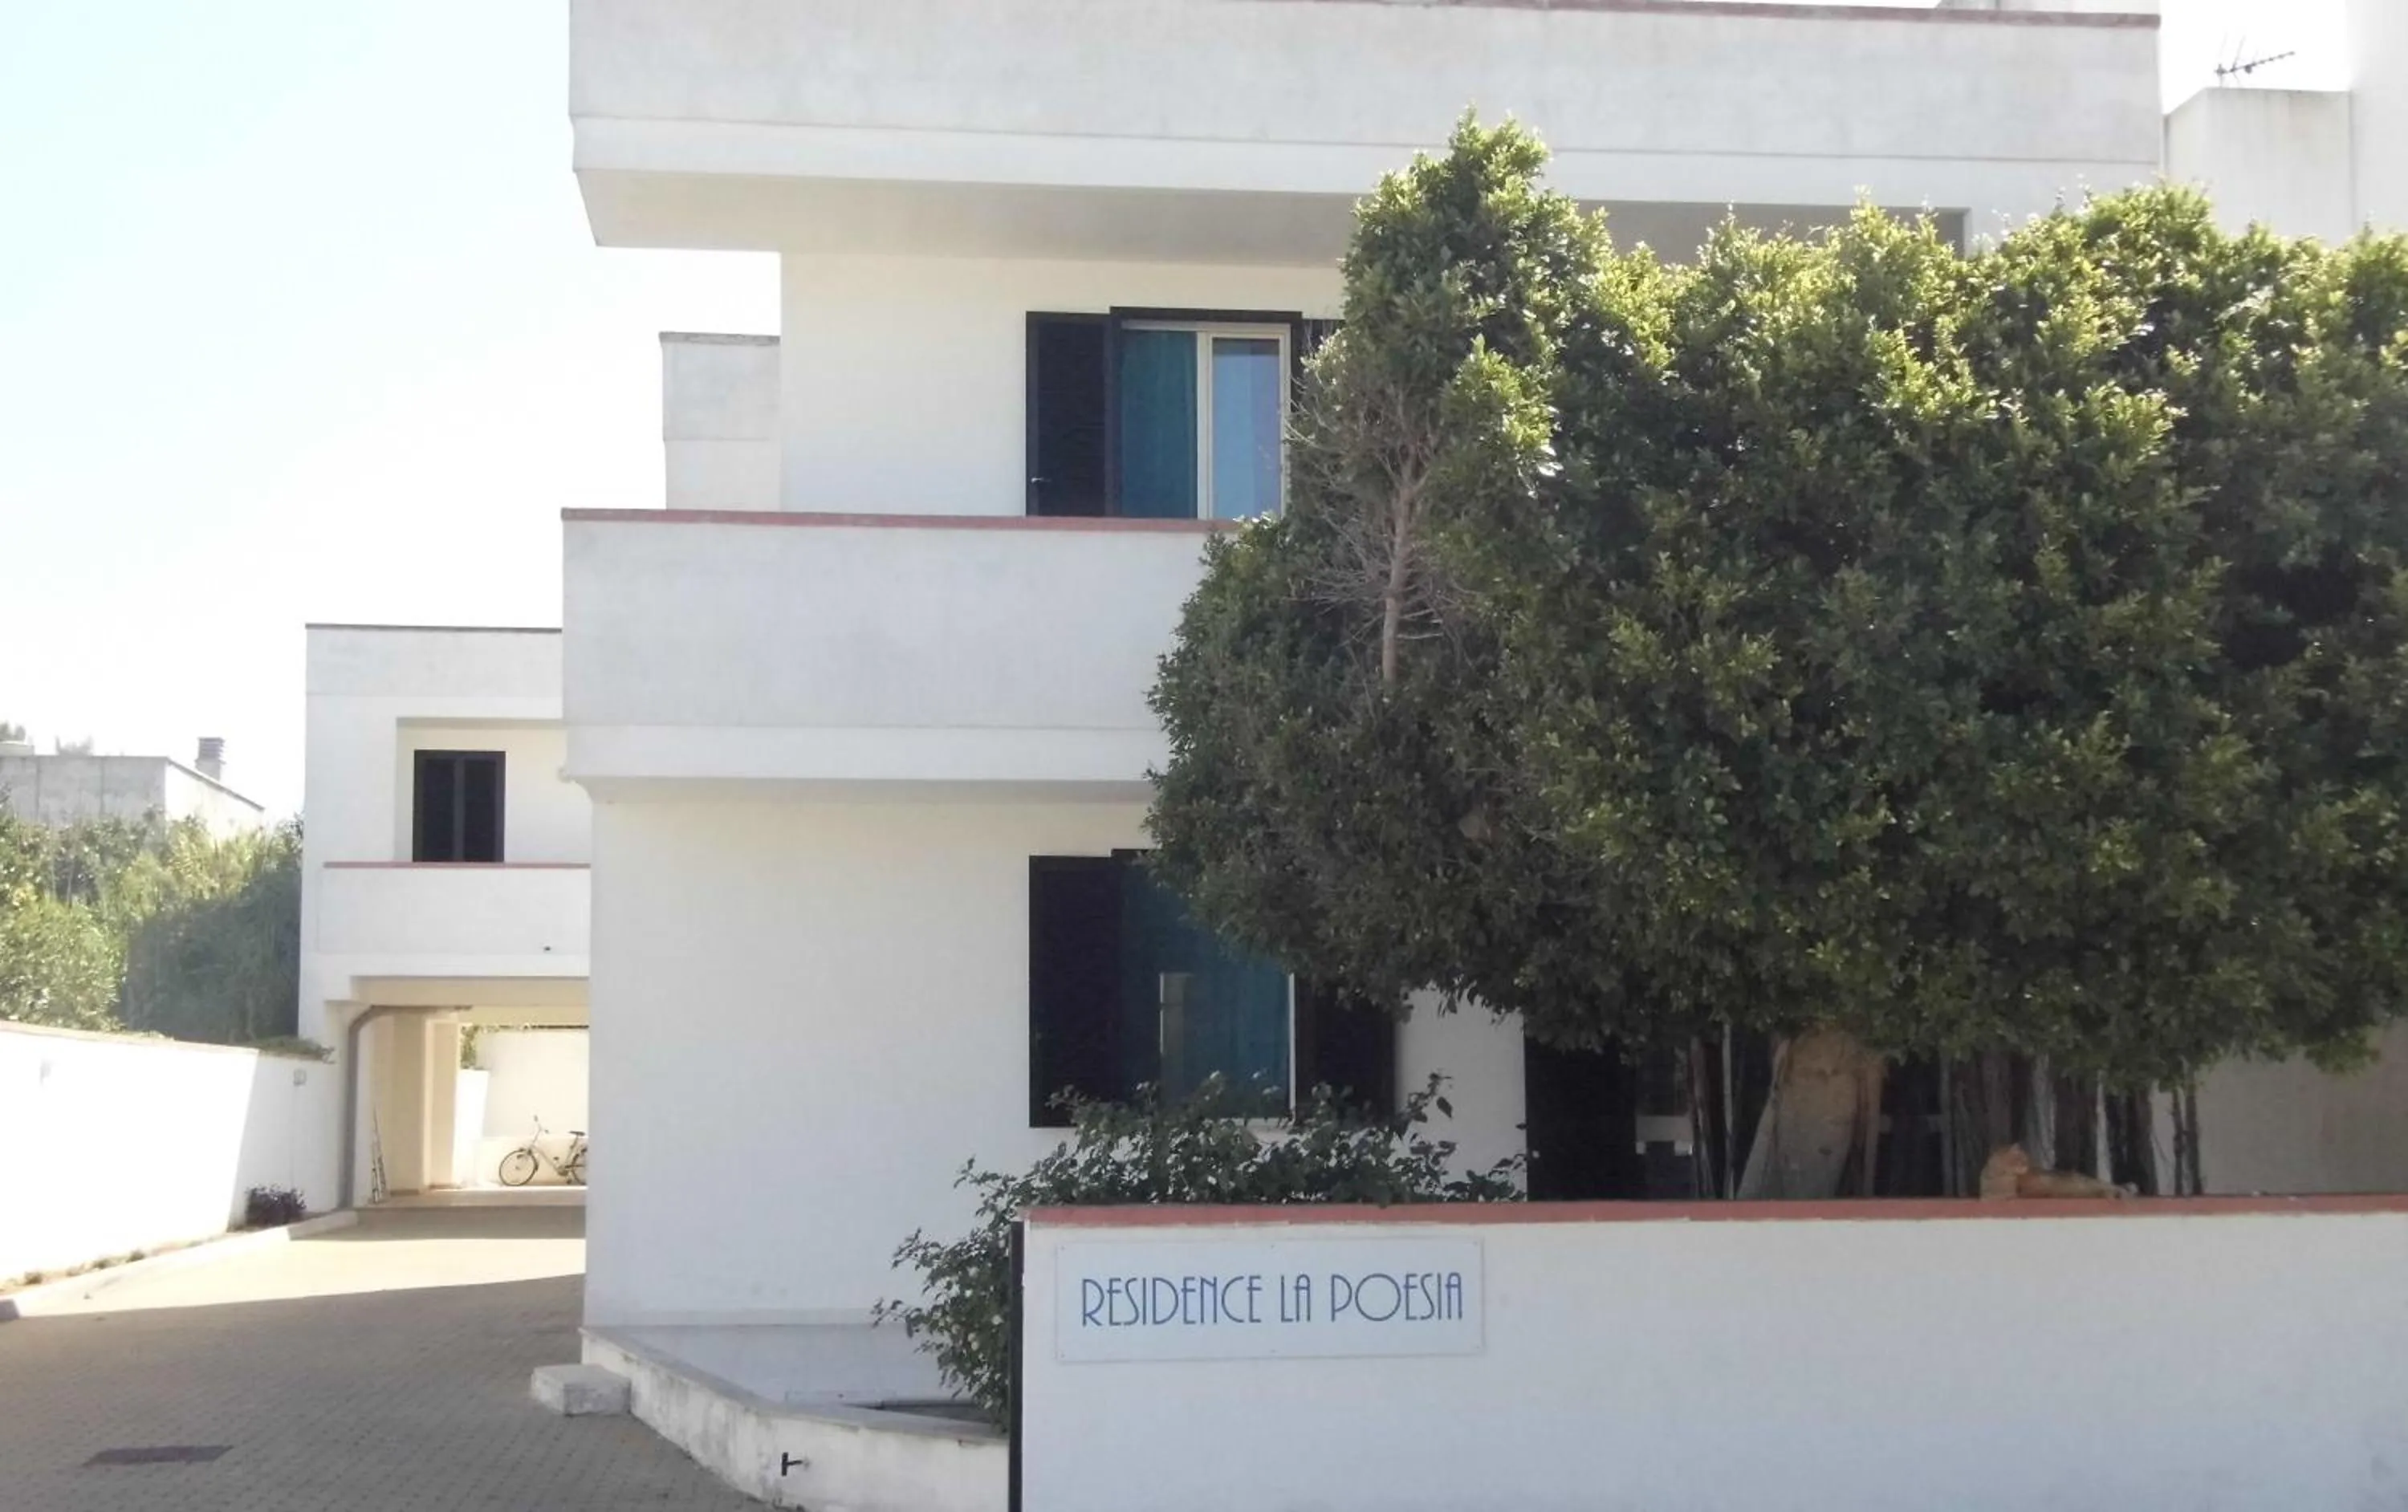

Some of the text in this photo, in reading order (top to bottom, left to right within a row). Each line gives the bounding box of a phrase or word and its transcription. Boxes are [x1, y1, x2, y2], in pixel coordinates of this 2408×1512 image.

[1081, 1272, 1463, 1327] RESIDENCE LA POESIA
